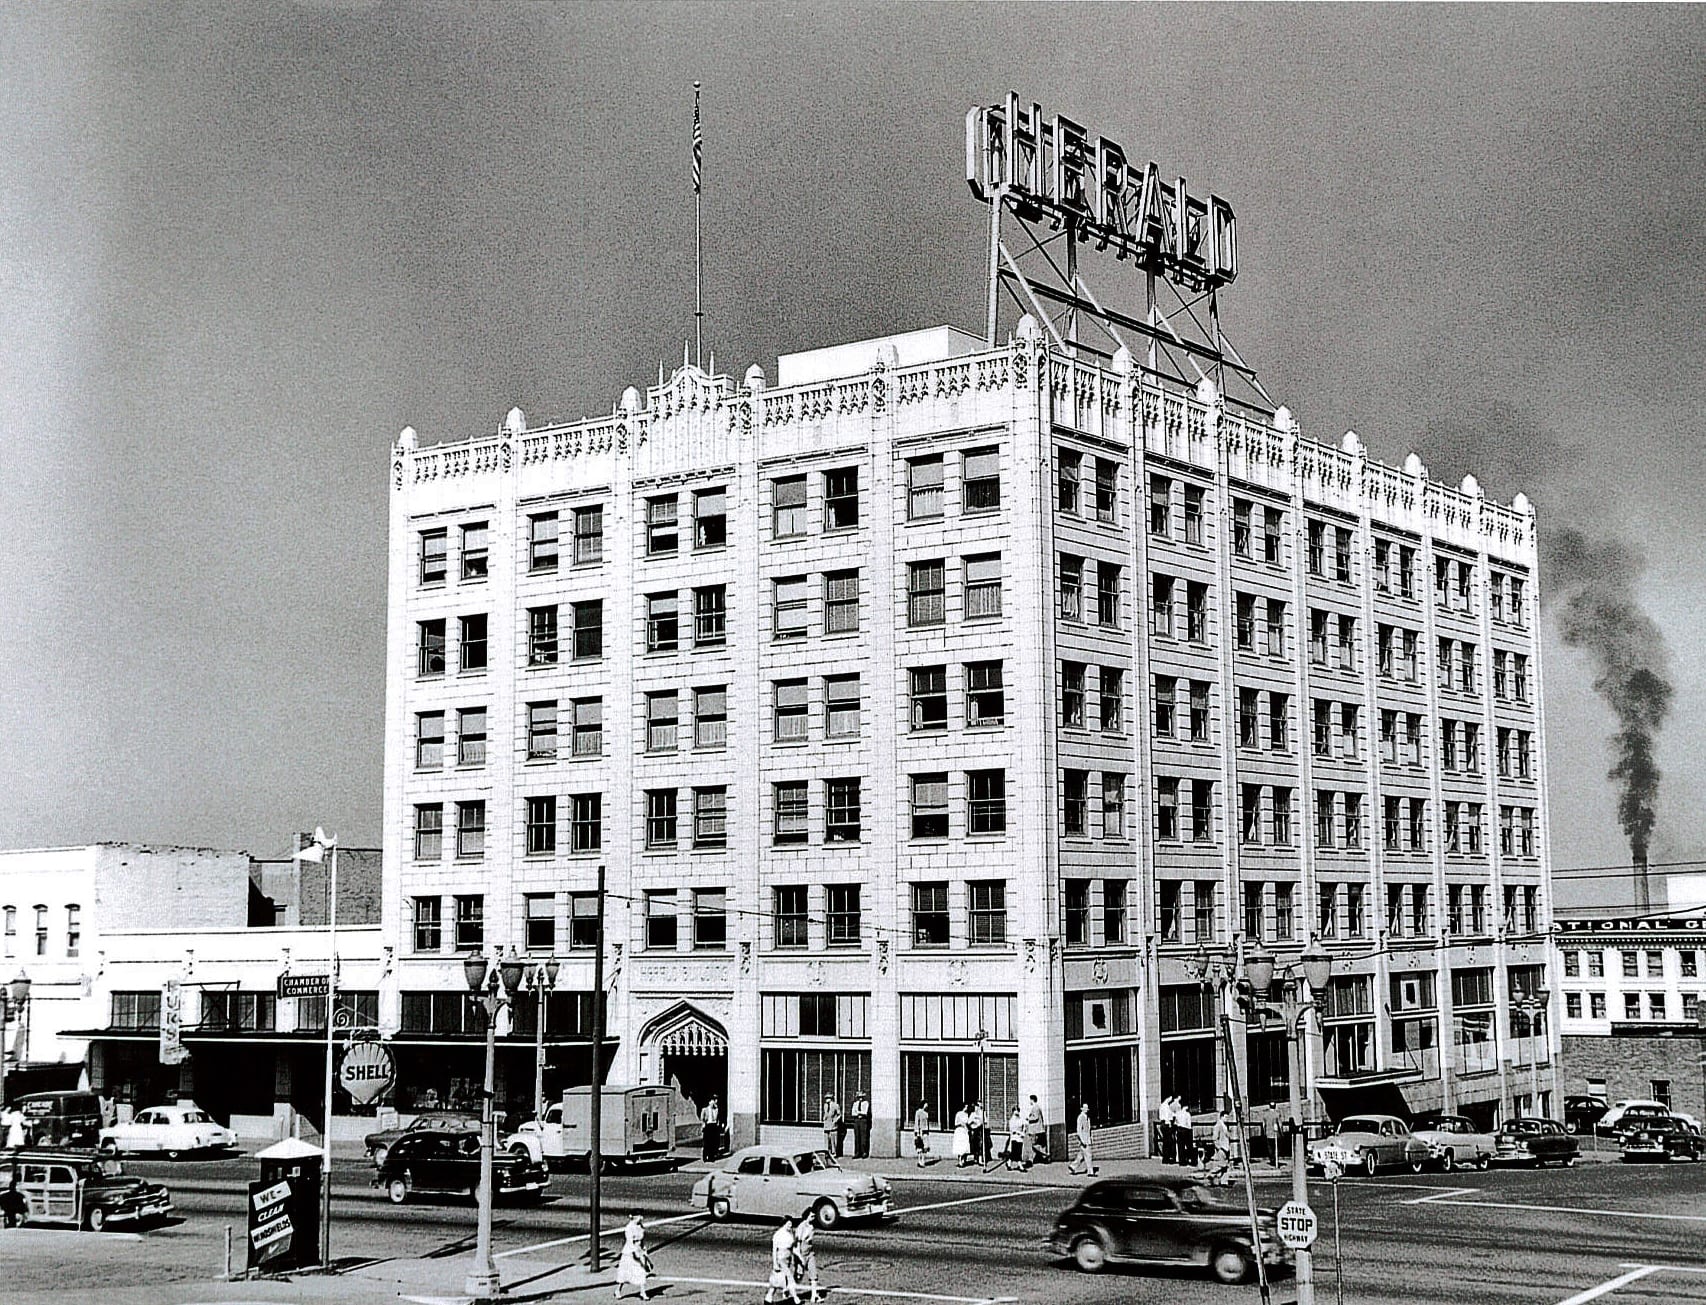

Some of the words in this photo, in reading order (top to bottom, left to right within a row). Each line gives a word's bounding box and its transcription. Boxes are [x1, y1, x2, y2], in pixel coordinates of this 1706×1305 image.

[1004, 90, 1238, 284] HERALD
[284, 977, 320, 986] CHAMBER
[286, 985, 328, 995] COMMERCE
[345, 1064, 389, 1081] SHELL
[257, 1202, 285, 1223] CLEAN
[1286, 1206, 1306, 1215] STATE
[1281, 1217, 1313, 1232] STOP
